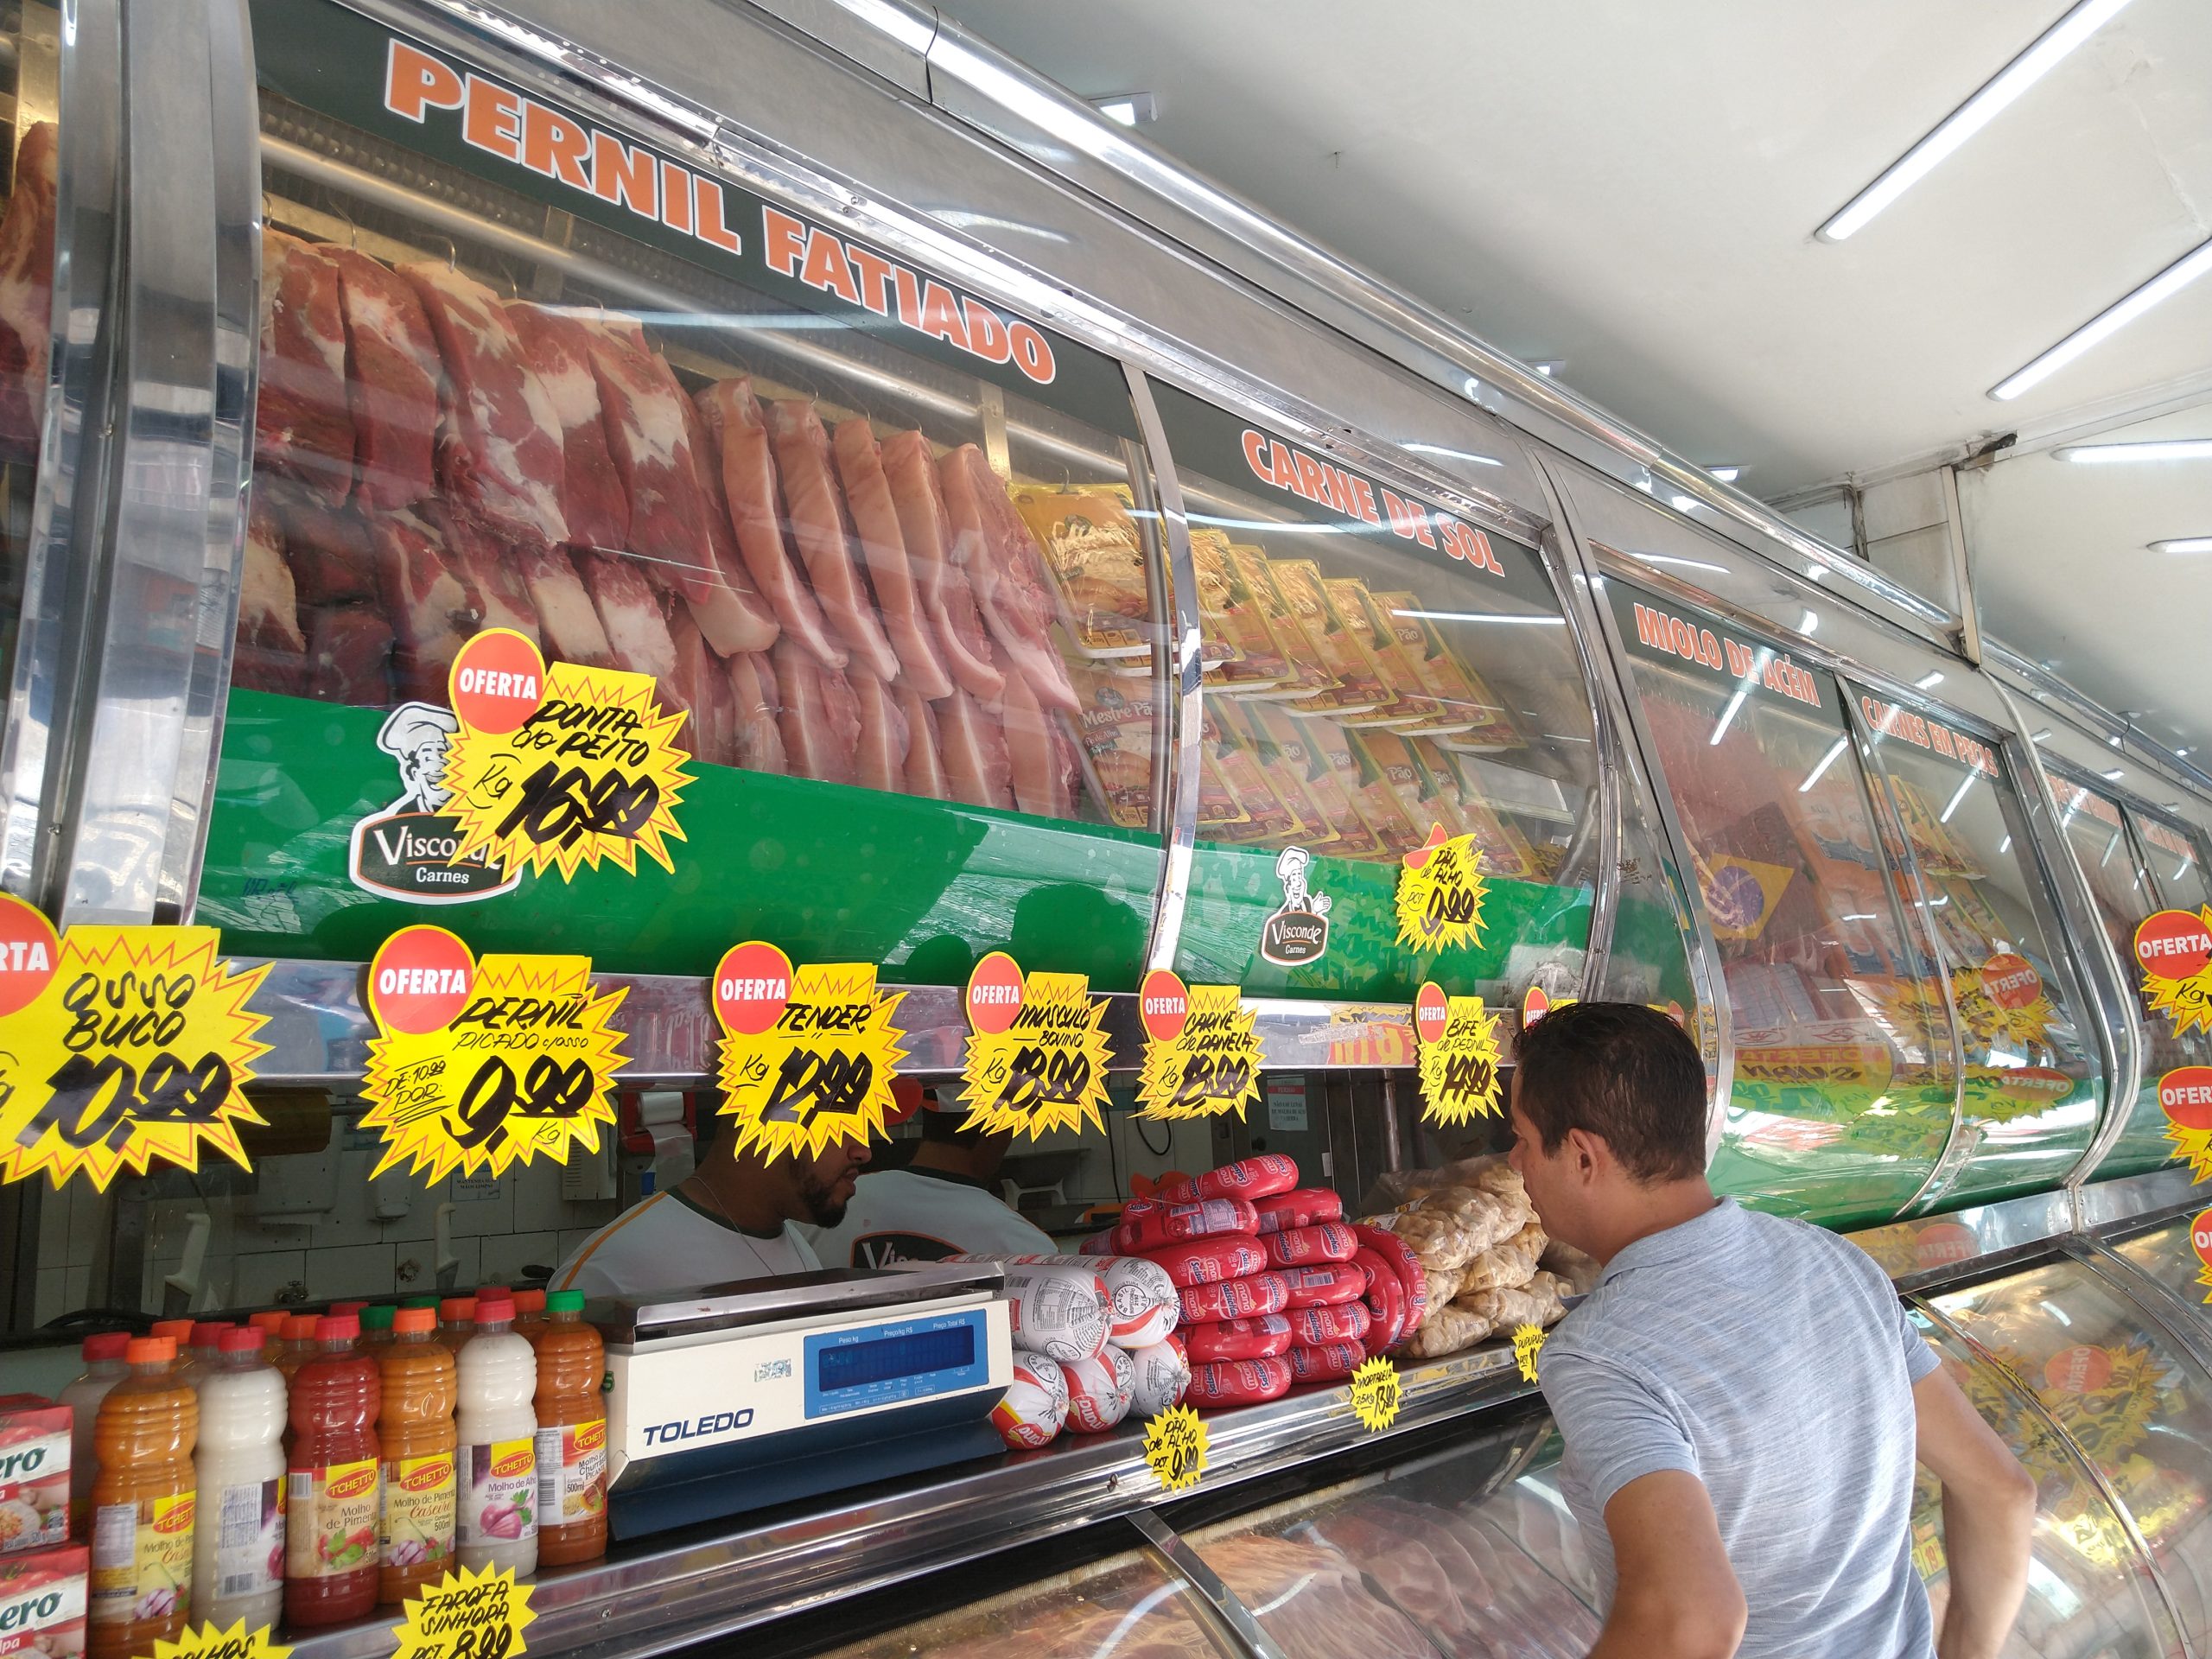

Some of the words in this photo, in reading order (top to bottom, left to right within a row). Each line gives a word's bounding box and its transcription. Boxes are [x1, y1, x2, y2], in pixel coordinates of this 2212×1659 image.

[384, 37, 741, 257] PERNIL
[763, 205, 1056, 385] FATIADO
[1242, 429, 1382, 528] CARNE
[1381, 487, 1437, 550] DE
[1434, 512, 1505, 577] SOL
[1397, 627, 1419, 641] Pão
[1633, 602, 1723, 671] MIOLO
[1724, 637, 1761, 686] DE
[1763, 655, 1821, 708] ACÉM
[459, 666, 537, 700] OFERTA
[523, 700, 643, 735] PONTA
[1083, 707, 1133, 728] Mestre
[1130, 702, 1152, 716] Pã
[1862, 696, 1930, 749] CARNES
[1928, 721, 1957, 760] EM
[556, 729, 650, 766] PEITO
[1328, 753, 1351, 766] Pão
[474, 764, 513, 800] Kg
[1389, 766, 1412, 780] Pão
[1432, 848, 1458, 869] PÃO
[416, 867, 470, 884] Carnes
[1433, 868, 1463, 886] ALHO
[1272, 920, 1322, 944] Visconde
[1285, 944, 1306, 955] Carnes
[2139, 933, 2212, 958] OFERTA
[379, 969, 467, 995] OFERTA
[721, 978, 785, 1001] OFERTA
[2175, 982, 2204, 1003] Kg
[972, 985, 1020, 1004] OFERTA
[448, 995, 588, 1032] PERNIL
[1146, 997, 1185, 1015] OFERTA
[1419, 1007, 1446, 1021] OFERTA
[777, 1003, 872, 1033] TENDER
[1184, 1010, 1236, 1036] CARNE
[1446, 1015, 1477, 1037] BIFE
[62, 1009, 187, 1052] BUCO
[453, 1031, 540, 1051] PICADO
[1039, 1031, 1084, 1047] BOVINO
[1176, 1034, 1197, 1051] de
[1196, 1032, 1253, 1053] PANELA
[1437, 1038, 1451, 1051] de
[1451, 1038, 1489, 1052] PERNIL
[740, 1053, 769, 1081] Kg
[982, 1057, 1007, 1084] Kg
[1159, 1065, 1179, 1088] Kg
[532, 1121, 560, 1145] Kg
[1116, 1287, 1128, 1313] BRASIL
[852, 1335, 859, 1344] kg
[884, 1328, 905, 1338] Preço/kg
[1356, 1372, 1393, 1390] MORTADELA
[643, 1408, 754, 1446] TOLEDO
[1164, 1417, 1187, 1436] PÃO
[1149, 1437, 1163, 1452] de
[1167, 1428, 1198, 1449] ALHO
[494, 1454, 532, 1476] TCHETTO
[579, 1454, 598, 1467] Molho
[330, 1470, 375, 1496] TCHETTO
[404, 1465, 449, 1490] TCHETTO
[488, 1481, 514, 1492] Molho
[515, 1479, 525, 1489] de
[567, 1482, 585, 1493] 500ml
[340, 1503, 371, 1517] Molho
[394, 1497, 420, 1508] Molho
[423, 1495, 432, 1503] de
[326, 1519, 340, 1529] de
[144, 1539, 173, 1554] Molho
[420, 1580, 509, 1618] FAROFA
[0, 1592, 63, 1630] ero
